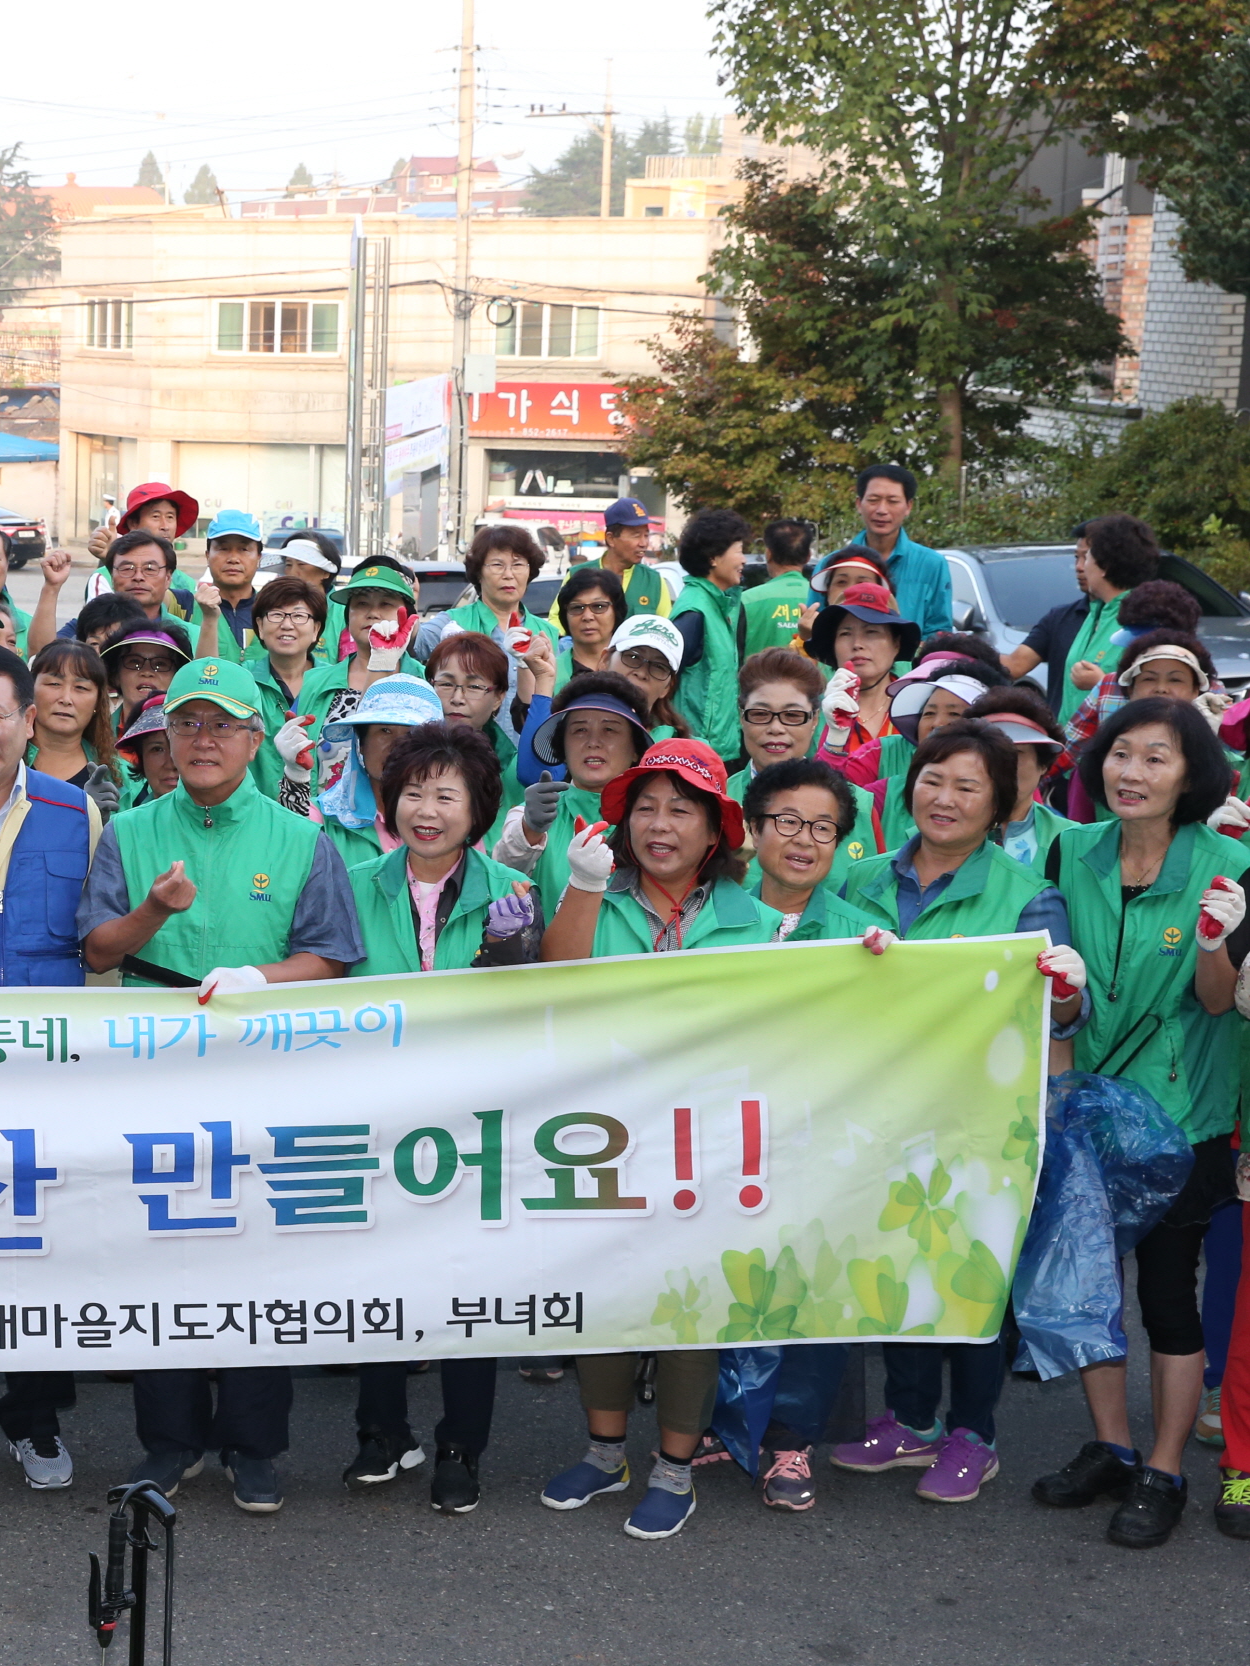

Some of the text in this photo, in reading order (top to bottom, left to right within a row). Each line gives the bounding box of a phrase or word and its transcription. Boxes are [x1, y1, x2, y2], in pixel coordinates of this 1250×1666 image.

[771, 603, 802, 621] 새마
[777, 621, 799, 629] SAEM
[198, 678, 219, 686] SMU
[249, 891, 271, 902] SMU
[1158, 947, 1182, 957] SMU
[106, 1014, 218, 1060] 내가
[239, 1004, 405, 1054] 깨끗이
[124, 1100, 764, 1232] 만들어요!!
[446, 1292, 584, 1338] 부녀회
